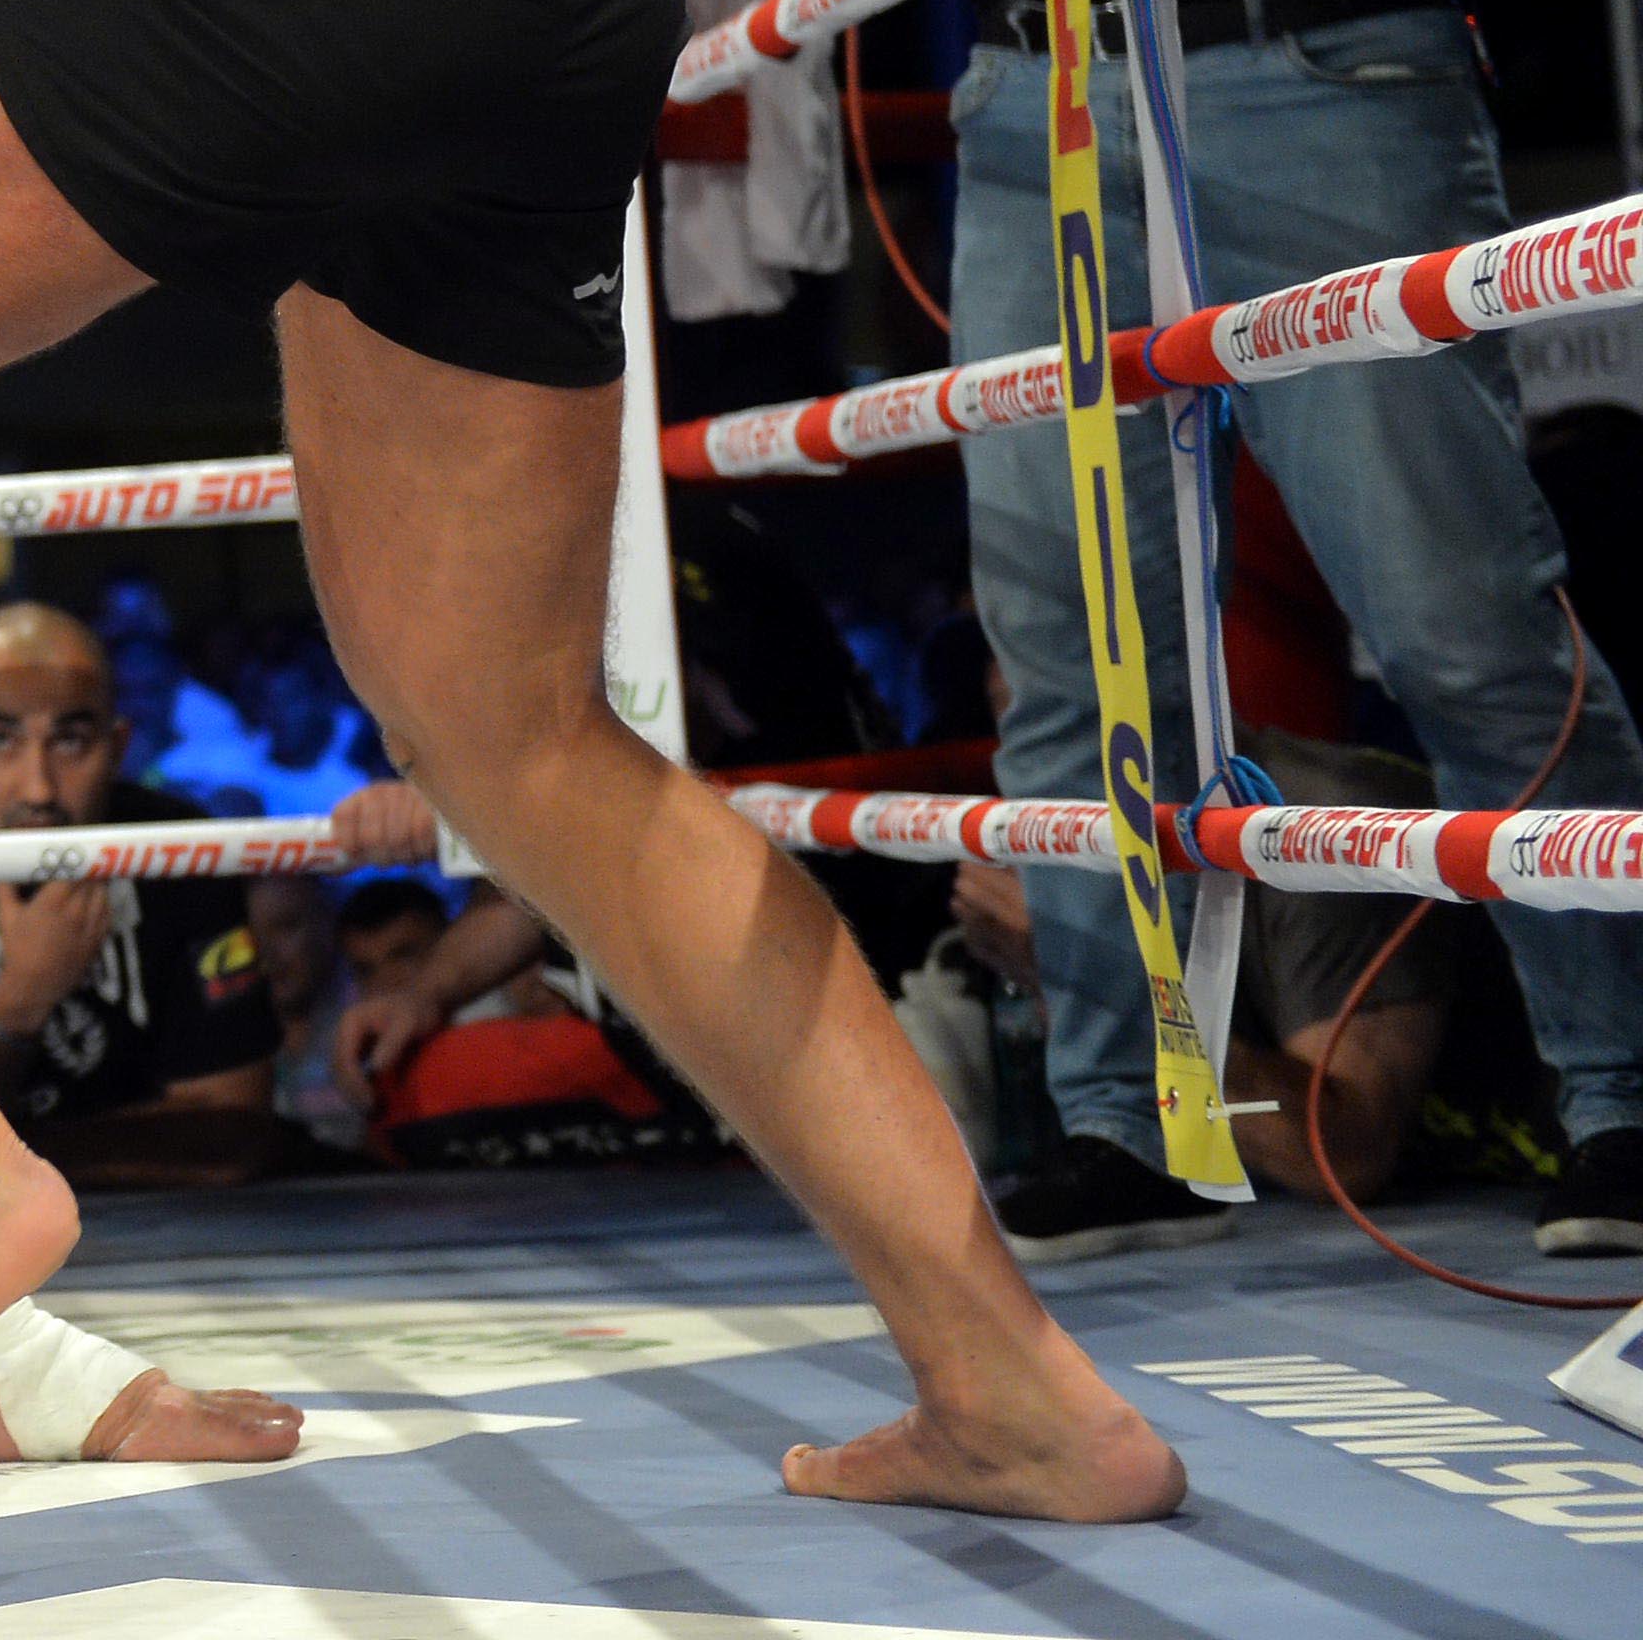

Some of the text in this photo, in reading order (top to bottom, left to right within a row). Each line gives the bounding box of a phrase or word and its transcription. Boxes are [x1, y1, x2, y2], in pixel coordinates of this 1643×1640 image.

[1500, 210, 1643, 313] AUTO SOF
[44, 467, 295, 530] AUTO SOF
